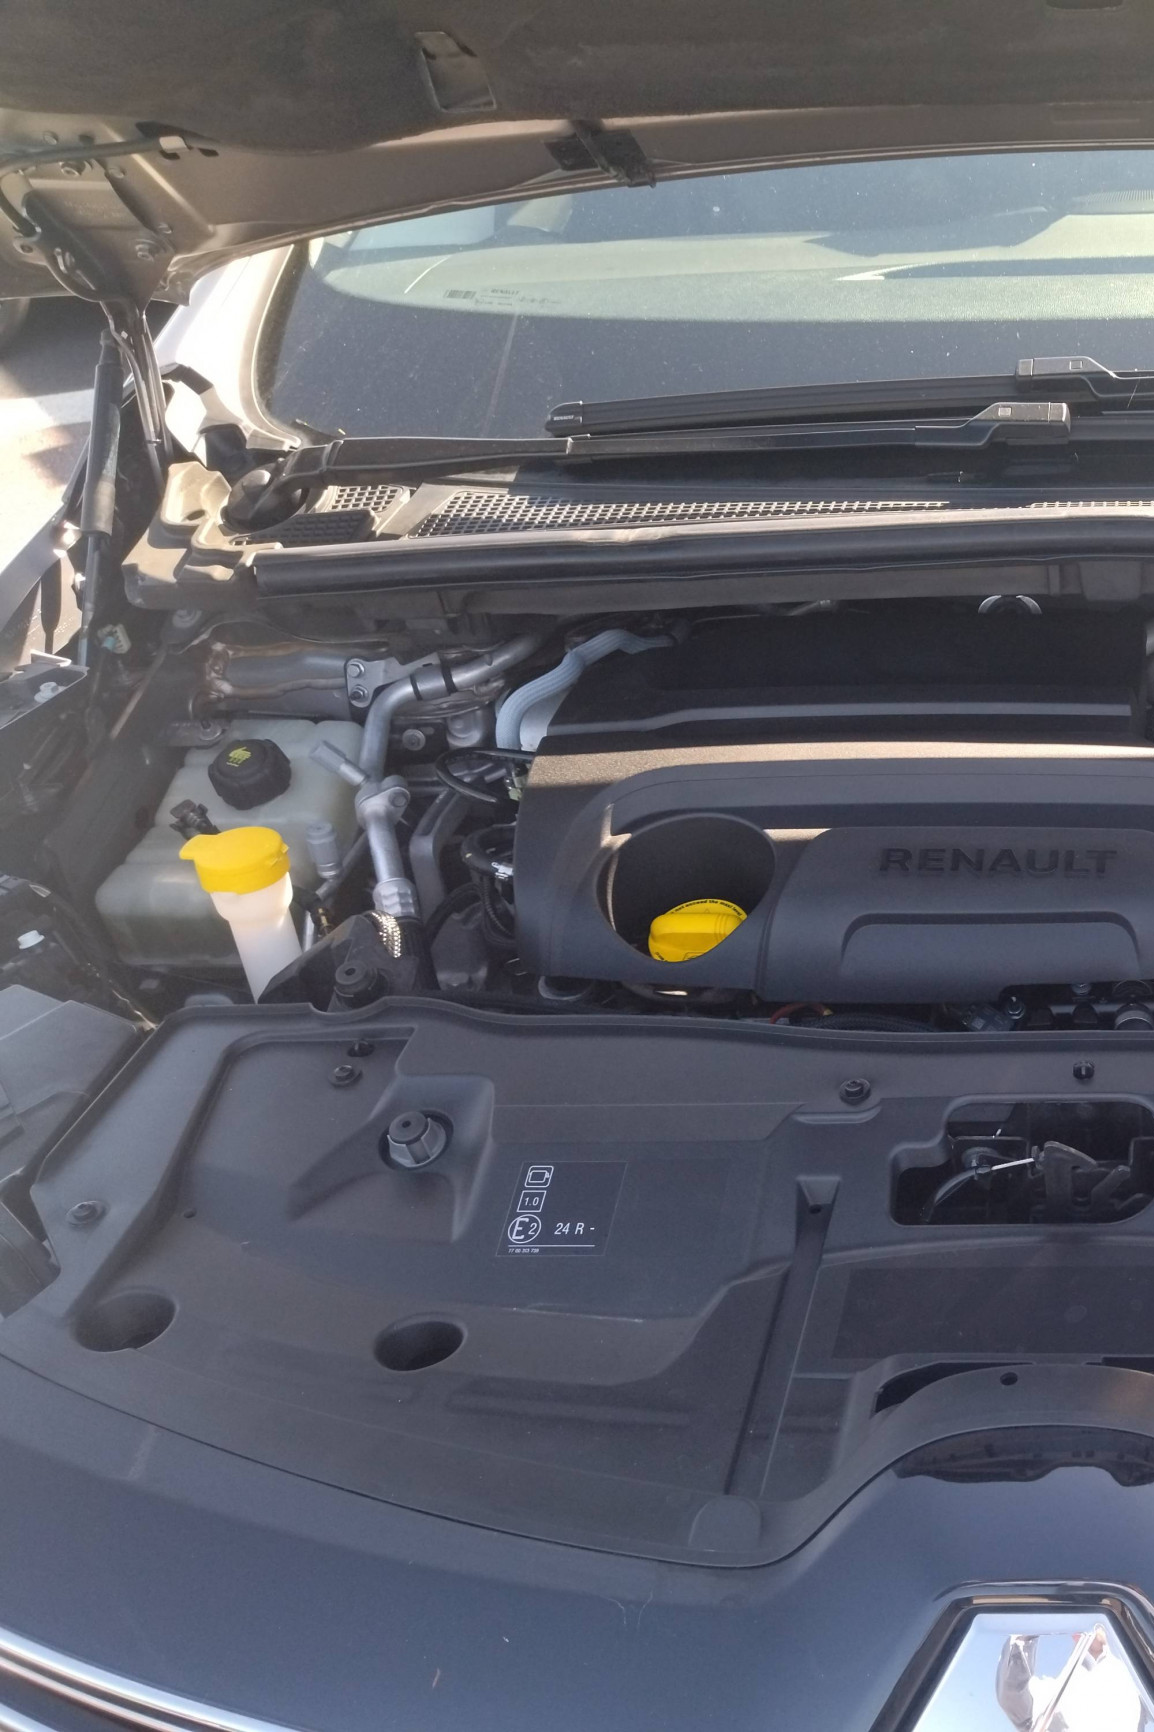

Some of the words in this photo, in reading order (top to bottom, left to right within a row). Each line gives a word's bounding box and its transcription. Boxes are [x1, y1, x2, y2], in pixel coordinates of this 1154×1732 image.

[878, 847, 1118, 877] RENAULT
[524, 1197, 539, 1206] 1.0
[554, 1222, 571, 1235] 24
